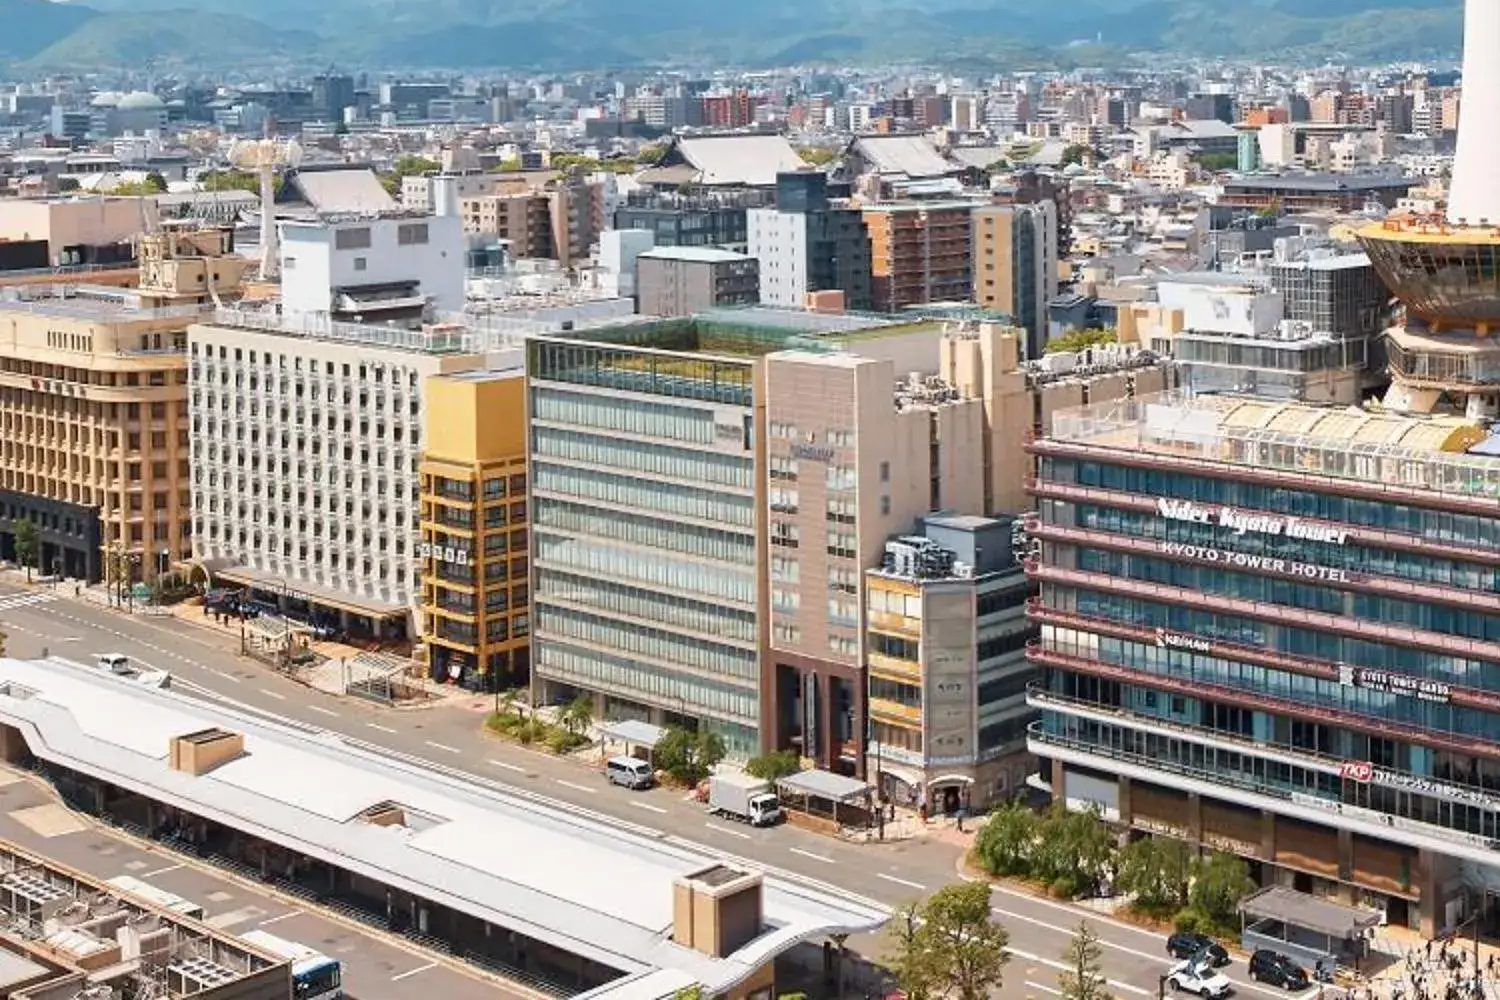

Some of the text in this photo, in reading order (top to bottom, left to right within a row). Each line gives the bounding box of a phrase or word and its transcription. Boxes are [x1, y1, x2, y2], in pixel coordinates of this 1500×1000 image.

[1219, 506, 1281, 535] Kyoto
[1285, 518, 1355, 545] Tower
[1162, 542, 1350, 584] KYOTO TOWER HOTEL
[1344, 763, 1369, 778] TKP
